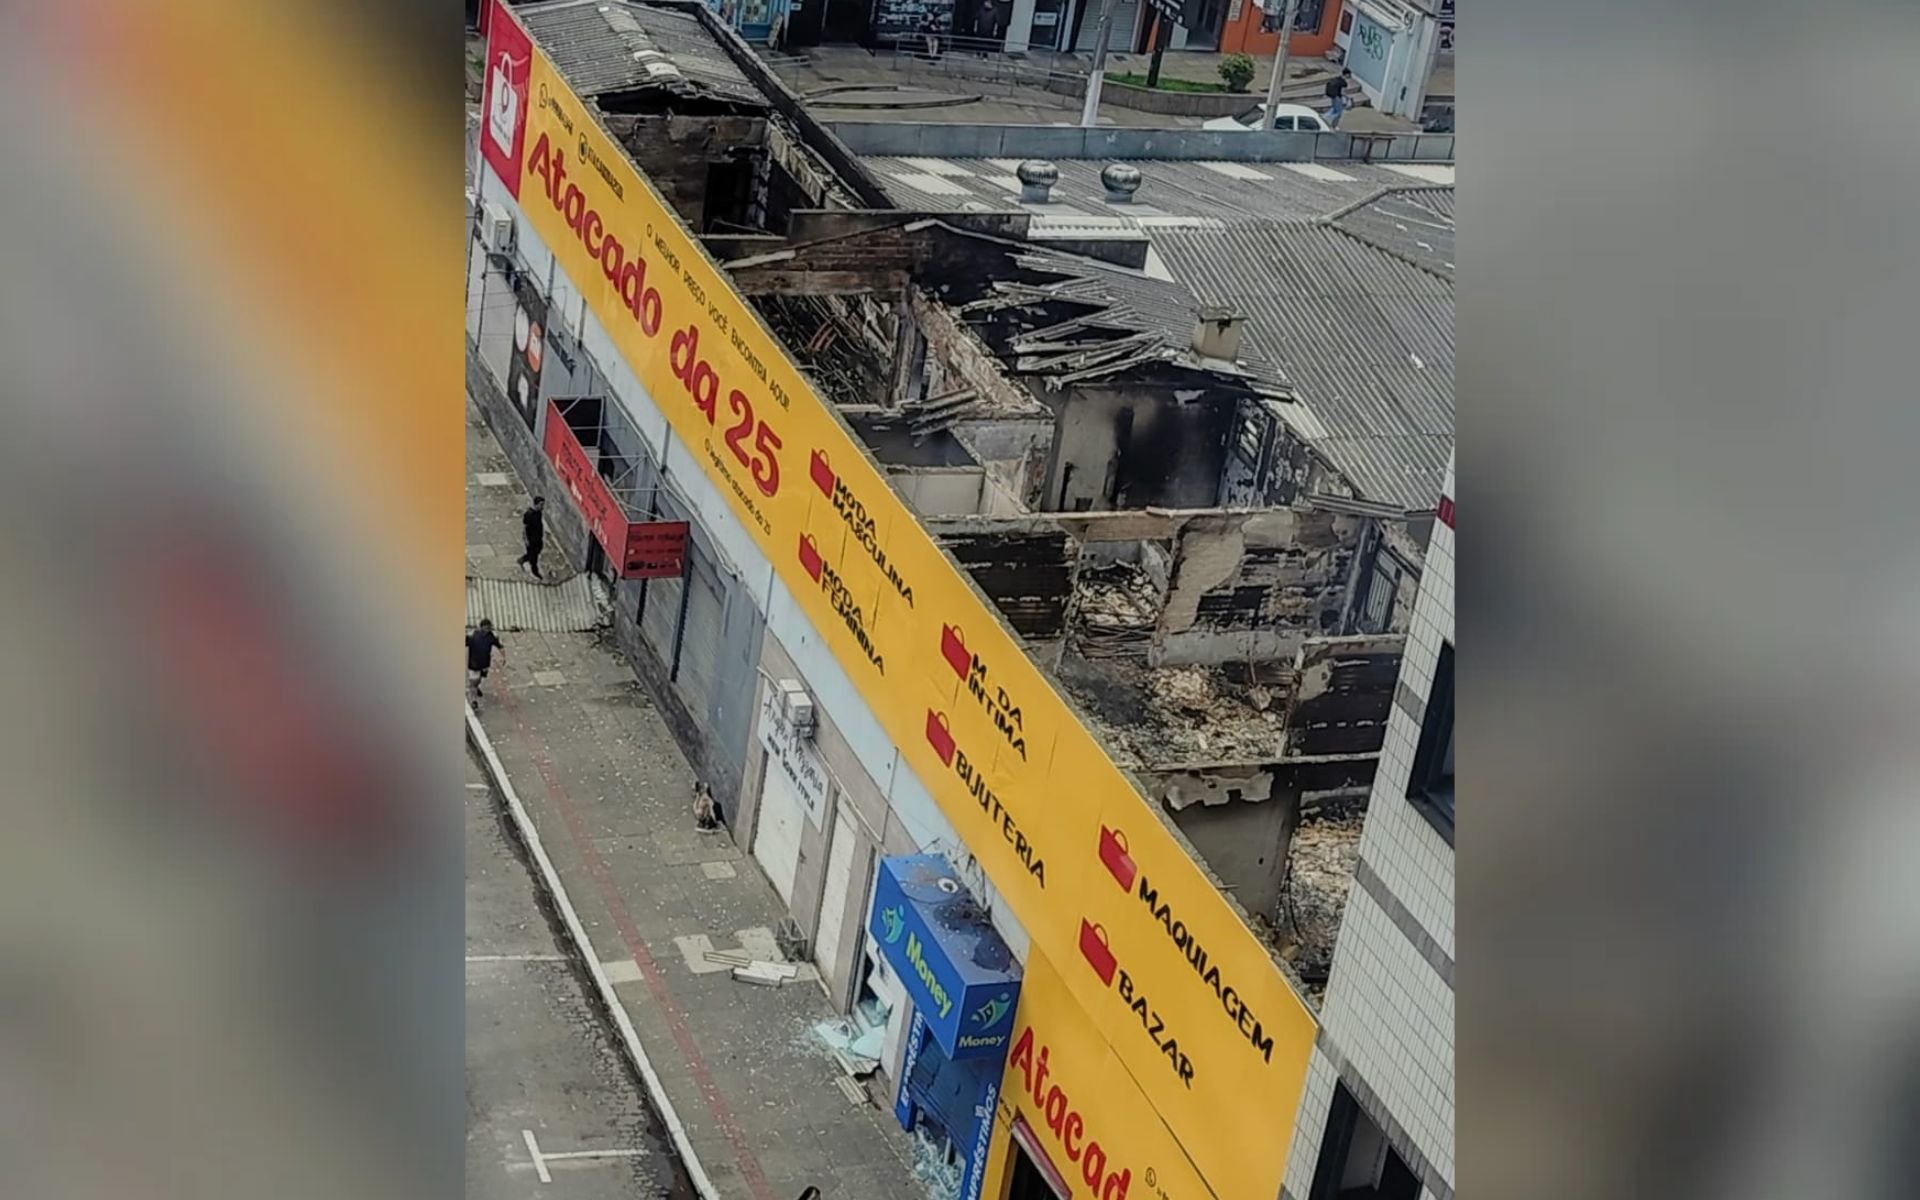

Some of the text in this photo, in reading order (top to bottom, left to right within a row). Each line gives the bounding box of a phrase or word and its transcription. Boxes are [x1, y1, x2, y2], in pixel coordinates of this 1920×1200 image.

[526, 131, 662, 337] Atacado
[670, 324, 720, 425] da
[724, 388, 784, 499] 25
[646, 223, 653, 237] O
[655, 232, 681, 275] MELHOR
[708, 302, 729, 337] VOCÊ
[730, 327, 767, 385] ENCONTRA
[832, 496, 915, 611] MASCULINA
[834, 475, 878, 538] MODA
[821, 578, 886, 678] FEMININA
[822, 560, 864, 627] MODA
[955, 749, 1047, 890] BIJUTERIA
[905, 932, 953, 1020] Money
[1138, 877, 1275, 1064] MAQUIAGEM
[958, 1032, 1006, 1050] Money
[1117, 969, 1195, 1089] BAZAR
